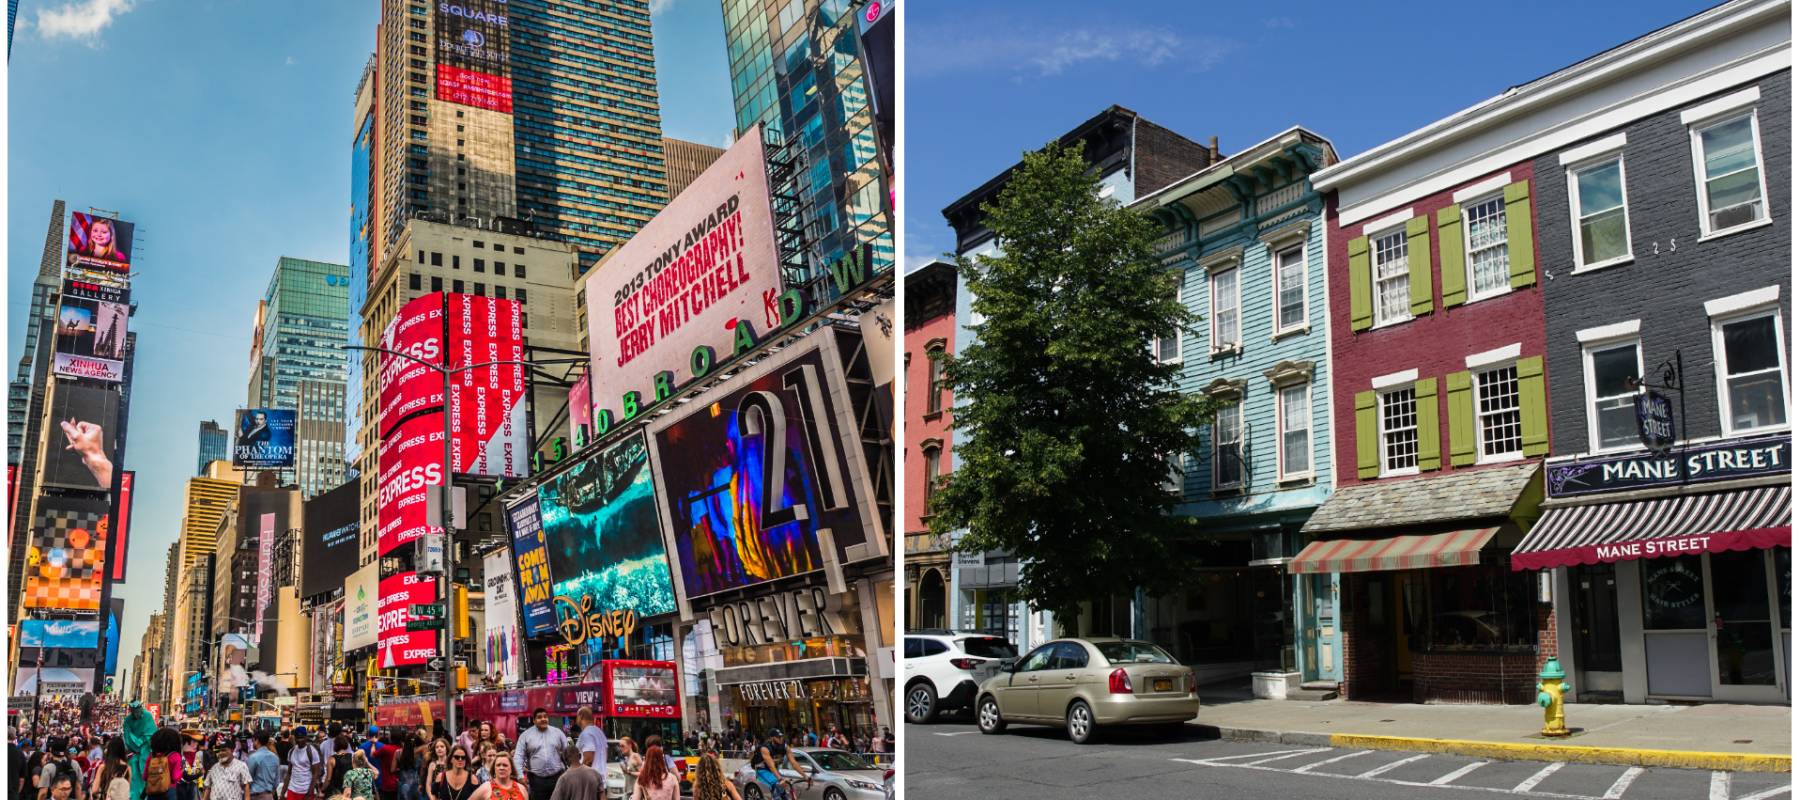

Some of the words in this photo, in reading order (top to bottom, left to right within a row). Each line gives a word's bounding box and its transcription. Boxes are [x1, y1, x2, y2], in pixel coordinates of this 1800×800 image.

[440, 3, 508, 25] SQUARE
[614, 272, 644, 307] 2013
[645, 239, 682, 280] TONY
[684, 194, 740, 251] AWARD
[614, 290, 640, 338] BEST
[642, 211, 744, 318] CHOREOGRAPHY!
[73, 289, 120, 300] GALLERY
[617, 317, 657, 368] JERRY
[659, 252, 750, 339] MITCHELL
[60, 365, 83, 374] NEWS
[84, 369, 118, 379] AGENCY
[70, 359, 109, 371] XINHUA
[381, 337, 439, 394] EXPRESS
[464, 340, 473, 387] EXPRESS
[489, 343, 498, 390] EXPRESS
[512, 346, 522, 391] EXPRESS
[452, 384, 460, 433] EXPRESS
[478, 386, 487, 435] EXPRESS
[502, 389, 512, 437] EXPRESS
[1642, 399, 1667, 418] MANE
[1643, 419, 1671, 437] STREET
[235, 446, 293, 455] PHANTOM
[737, 364, 849, 532] 21
[1602, 459, 1678, 481] MANE
[1687, 445, 1784, 475] STREET
[380, 463, 441, 510] EXPRESS
[518, 546, 546, 571] COME
[1597, 543, 1641, 559] MANE
[1645, 537, 1711, 553] STREET
[427, 605, 436, 614] 45
[524, 580, 550, 606] AWAY
[708, 587, 838, 650] FOREVER
[576, 691, 594, 703] VIEW
[740, 681, 790, 700] FOREVER
[791, 680, 806, 699] 21
